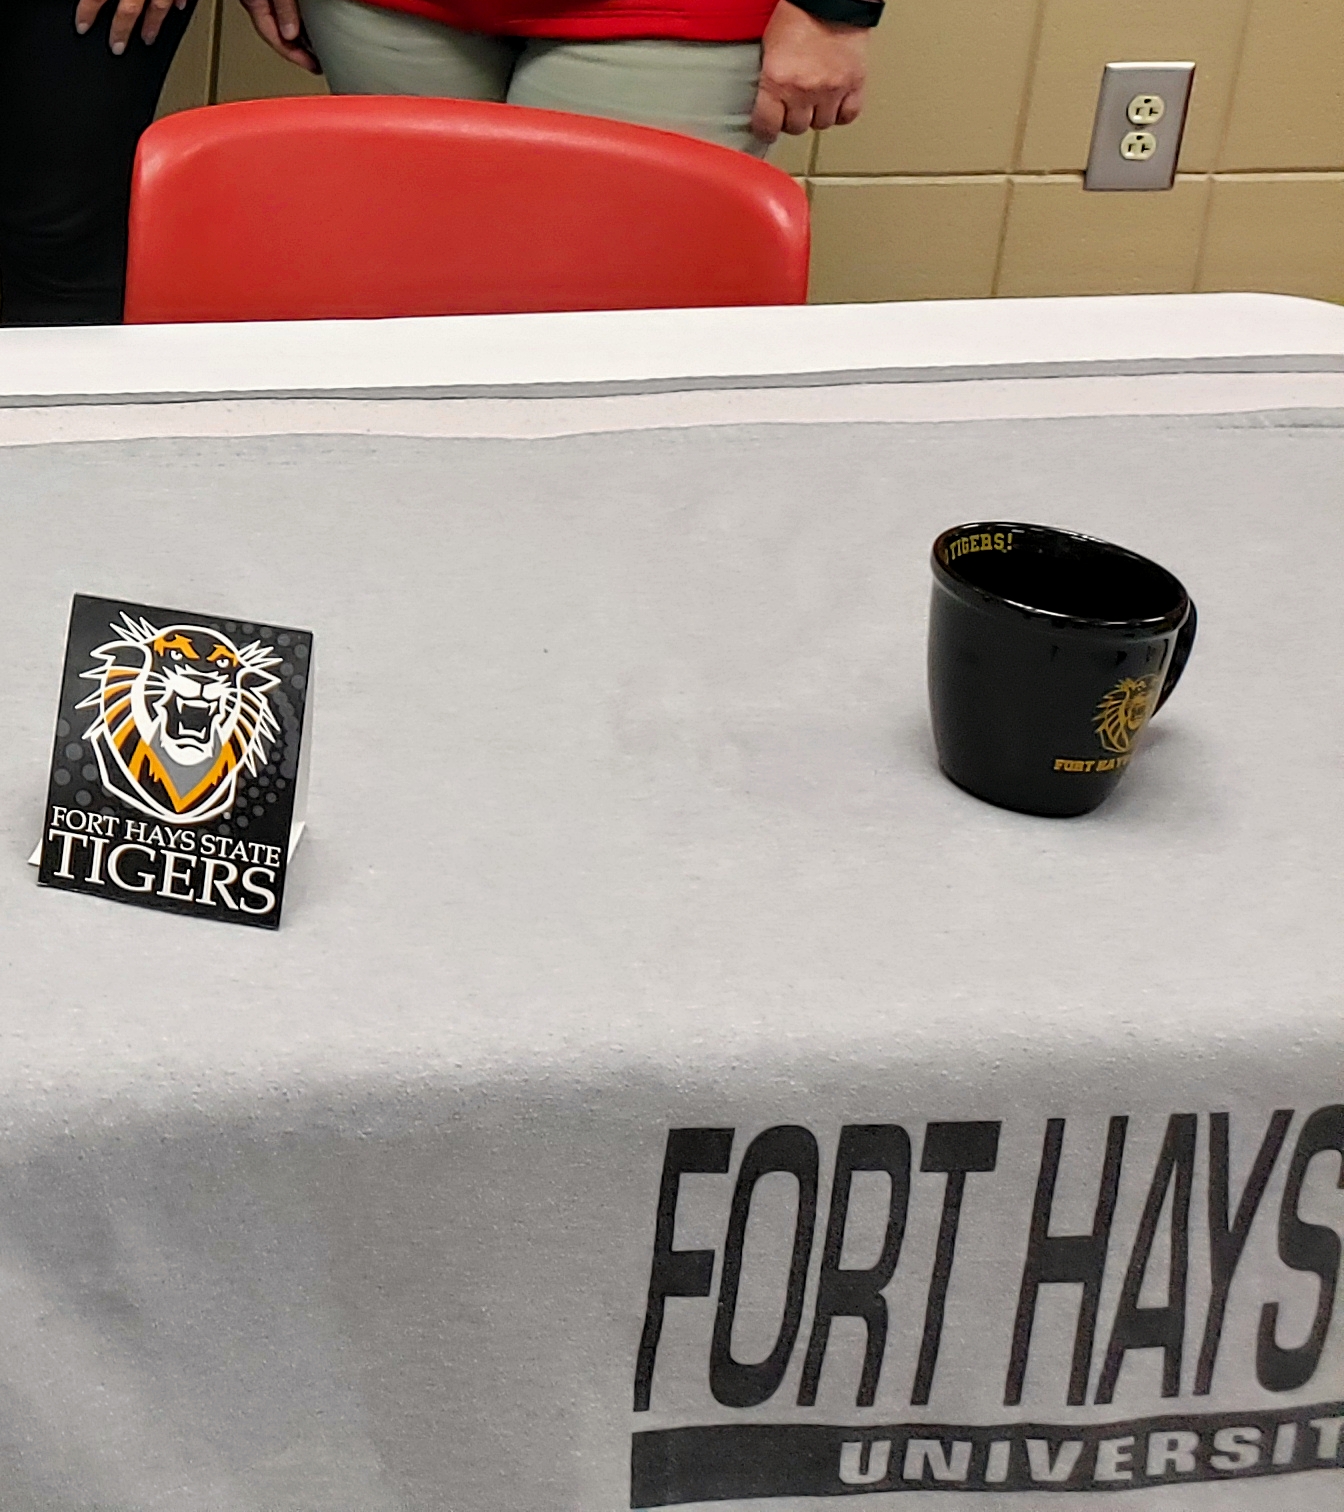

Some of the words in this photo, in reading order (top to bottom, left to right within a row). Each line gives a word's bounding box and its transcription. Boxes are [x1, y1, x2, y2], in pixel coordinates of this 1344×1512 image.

[48, 828, 277, 916] TIGERS
[50, 805, 120, 838] FORT
[124, 819, 196, 852] HAYS
[200, 834, 282, 868] STATE
[632, 1120, 1003, 1413] FORT
[1003, 1103, 1344, 1407] HAYS
